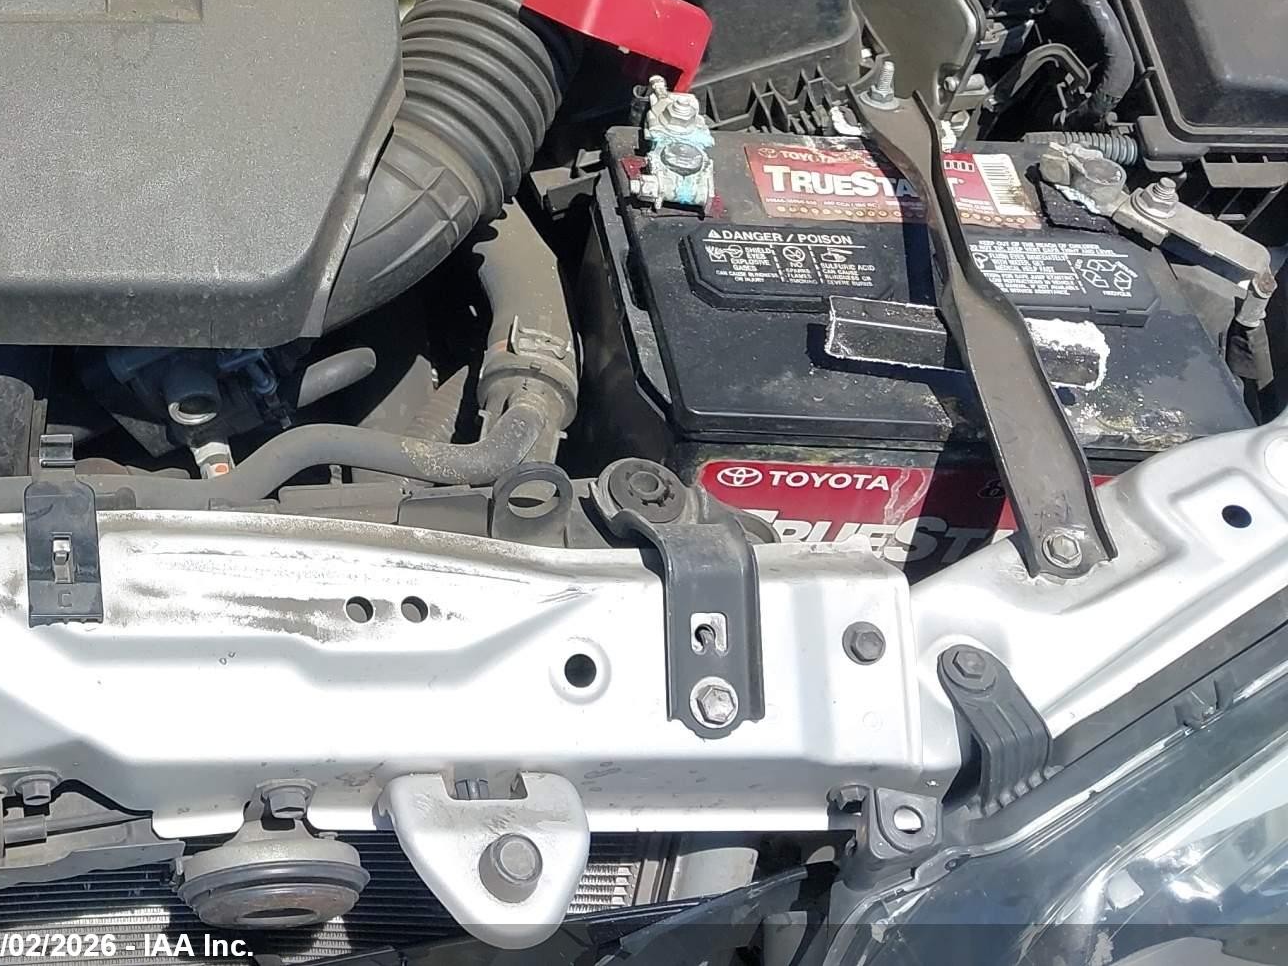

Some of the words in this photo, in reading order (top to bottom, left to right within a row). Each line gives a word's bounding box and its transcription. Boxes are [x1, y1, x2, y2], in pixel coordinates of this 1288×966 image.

[722, 230, 784, 243] DANGER
[798, 233, 853, 245] POISON
[744, 246, 771, 254] SHIELD
[820, 262, 856, 271] SULFURIC
[857, 264, 876, 272] ACID
[769, 470, 890, 492] TOYOTA
